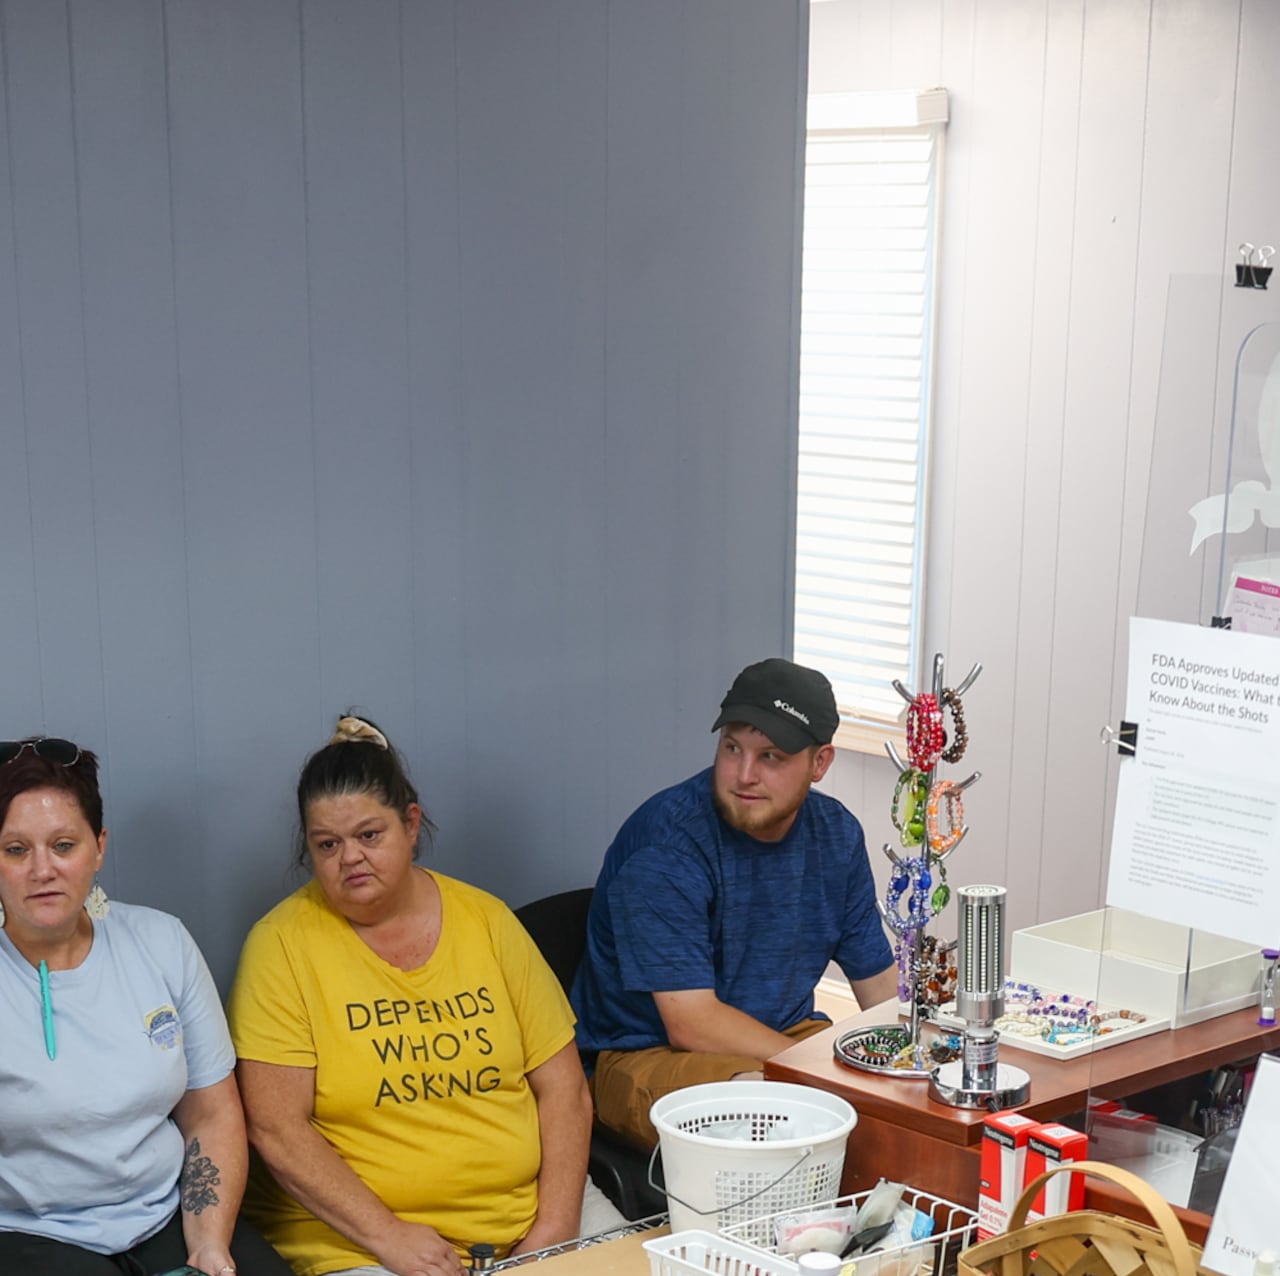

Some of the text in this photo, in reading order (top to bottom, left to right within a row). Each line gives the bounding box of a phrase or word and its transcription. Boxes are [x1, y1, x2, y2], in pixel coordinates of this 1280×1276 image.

[1152, 653, 1280, 687] FDA Approves Updated
[1150, 671, 1189, 690] COVID
[1190, 678, 1241, 699] Vaccines:
[1242, 687, 1275, 705] What
[1149, 690, 1181, 707] Know
[1182, 695, 1218, 714] About
[1220, 702, 1235, 717] the
[1237, 704, 1270, 724] Shots
[346, 986, 495, 1031] DEPENDS
[371, 1027, 493, 1065] WHO'S
